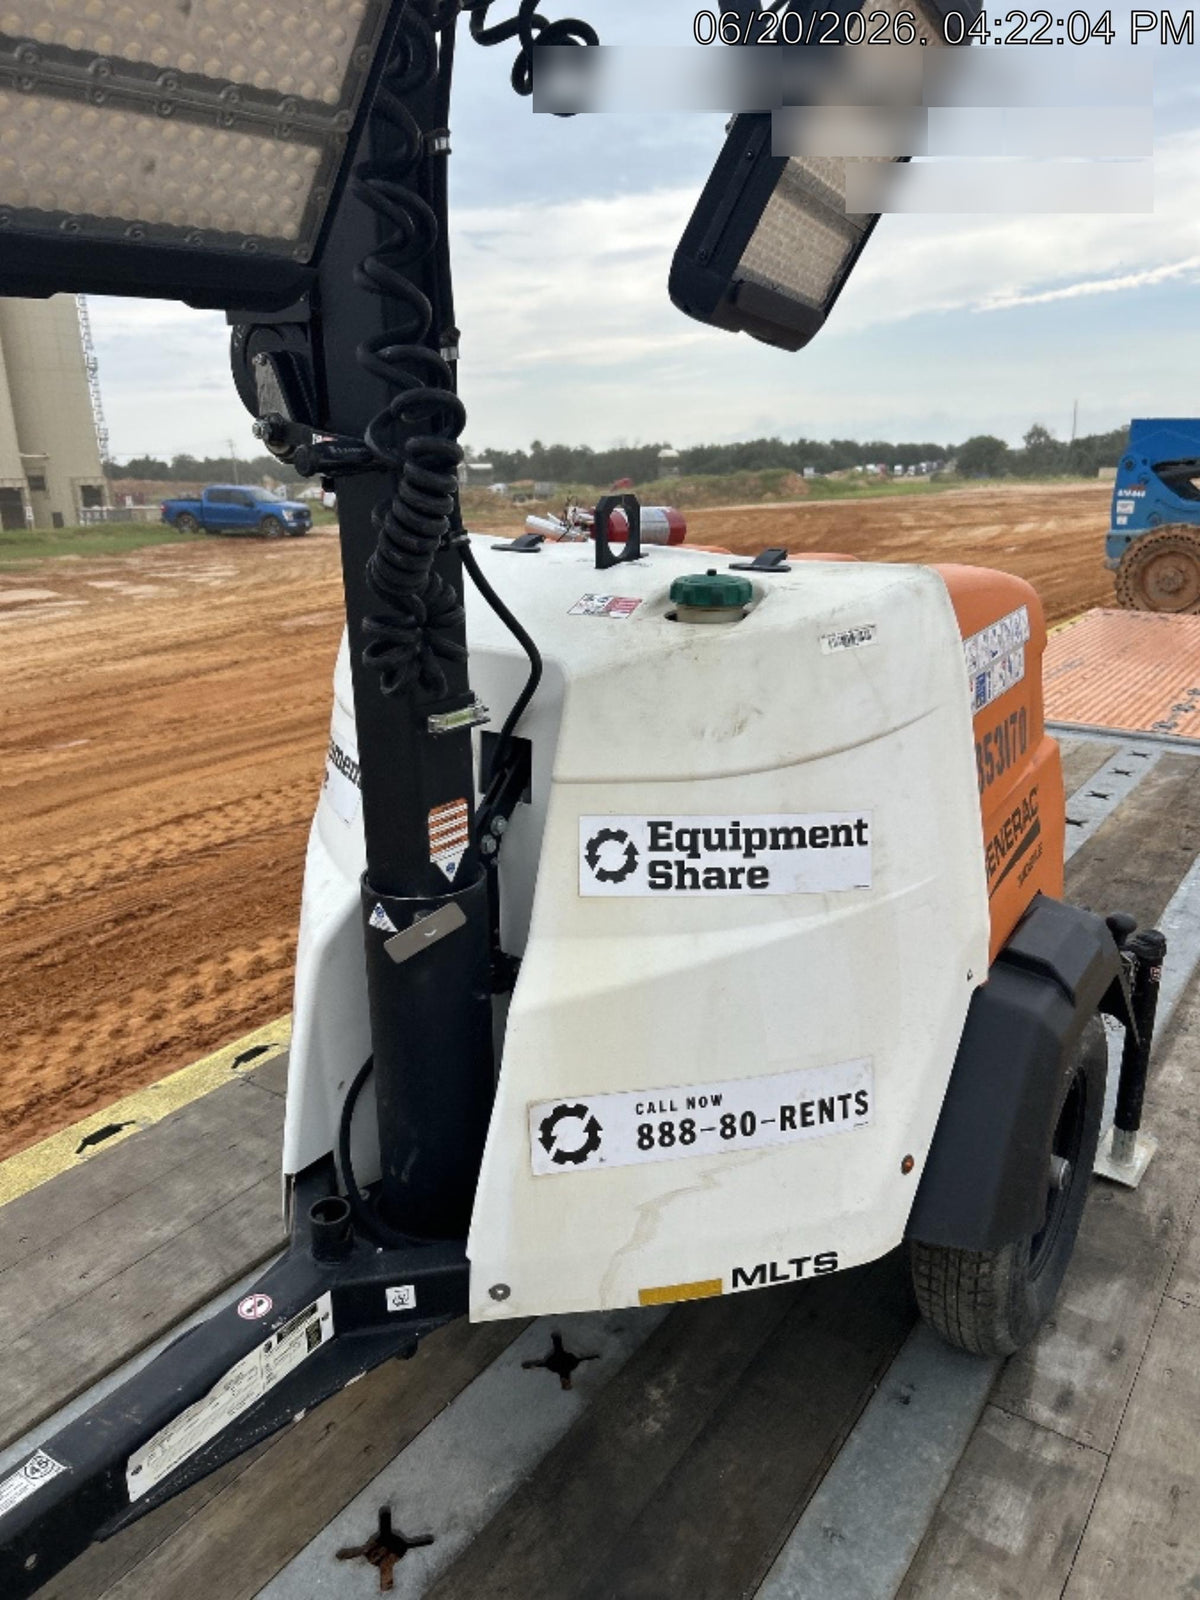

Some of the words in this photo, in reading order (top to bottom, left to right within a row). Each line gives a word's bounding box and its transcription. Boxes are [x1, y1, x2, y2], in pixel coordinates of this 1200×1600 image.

[647, 817, 869, 859] Equipment
[648, 859, 770, 890] Share
[635, 1100, 678, 1115] CALL
[686, 1093, 723, 1109] NOW
[636, 1089, 869, 1151] 888-80-RENTS
[731, 1250, 839, 1289] MLTS
